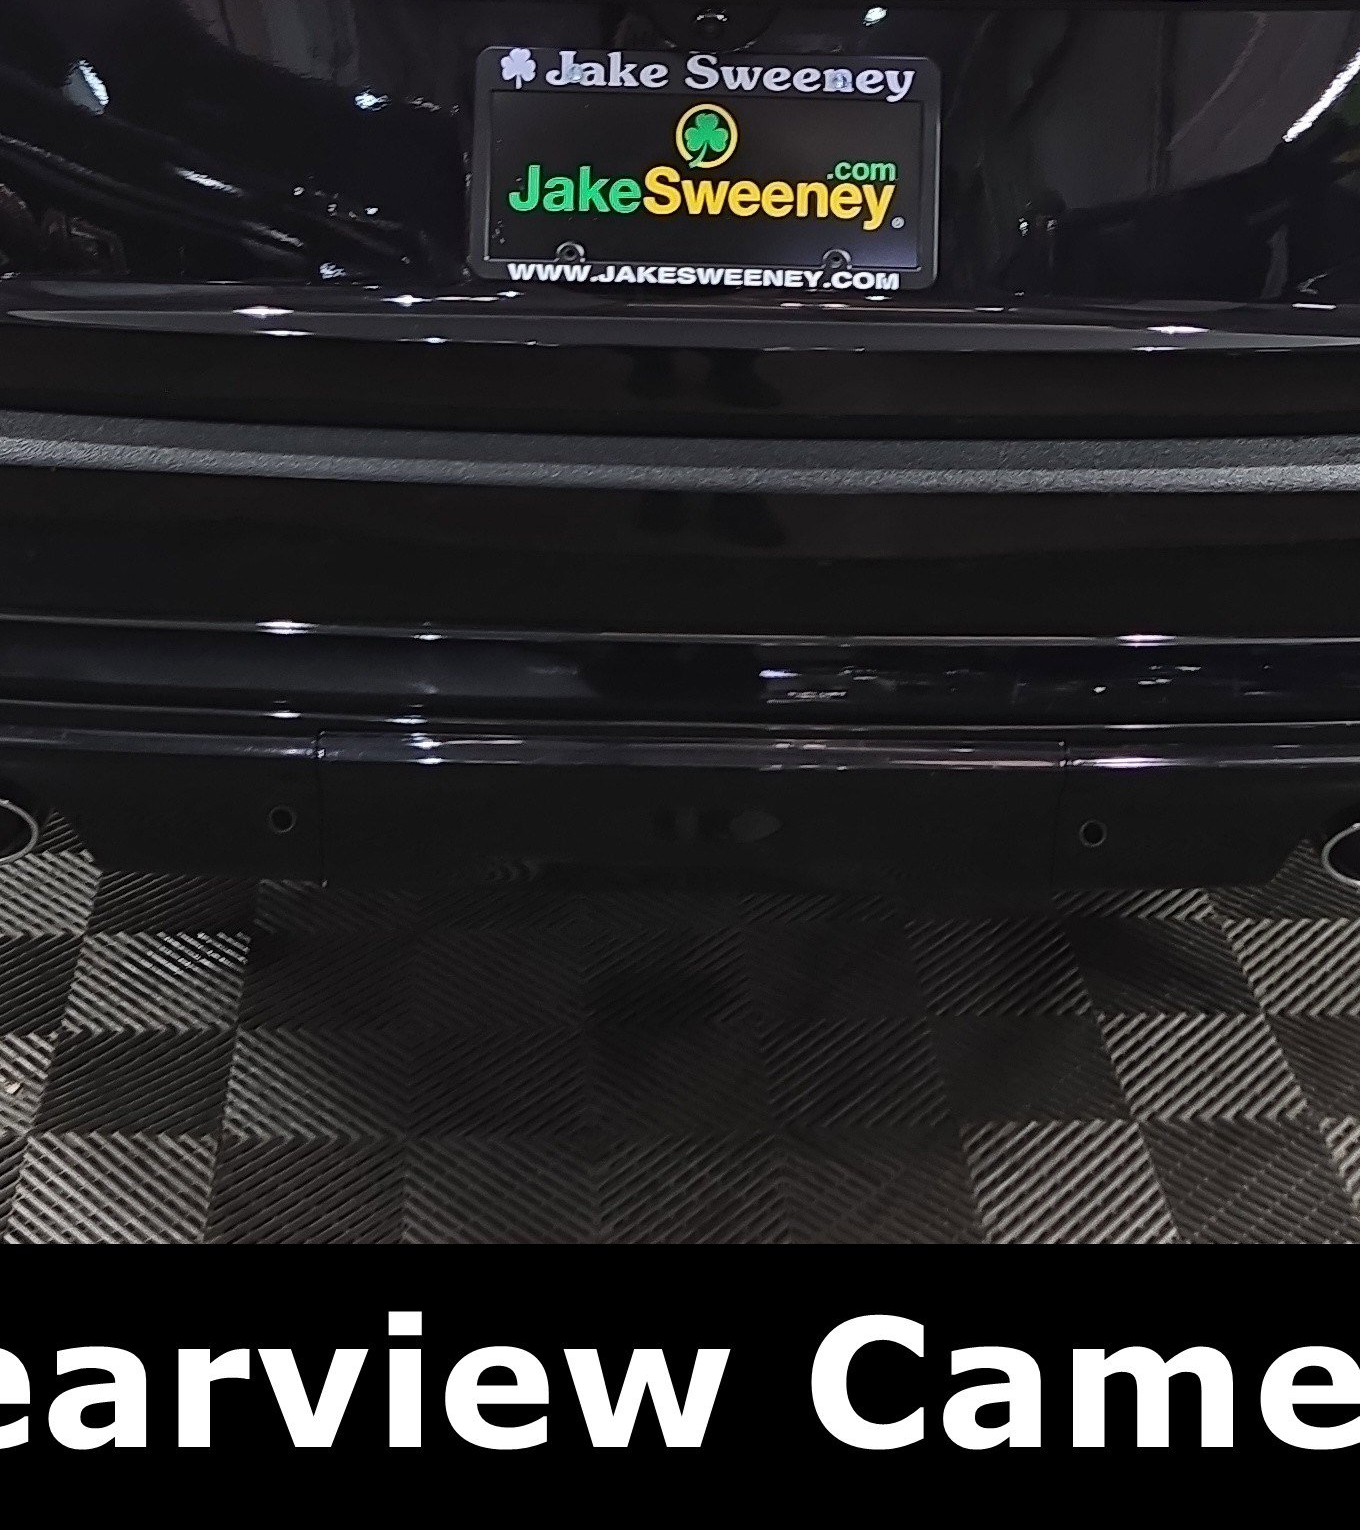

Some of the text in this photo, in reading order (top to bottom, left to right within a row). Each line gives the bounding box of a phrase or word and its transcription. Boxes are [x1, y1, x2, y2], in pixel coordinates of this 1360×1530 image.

[545, 50, 916, 103] Jake Sweeney
[507, 263, 901, 291] WWW.JAKESWEENEY.COM
